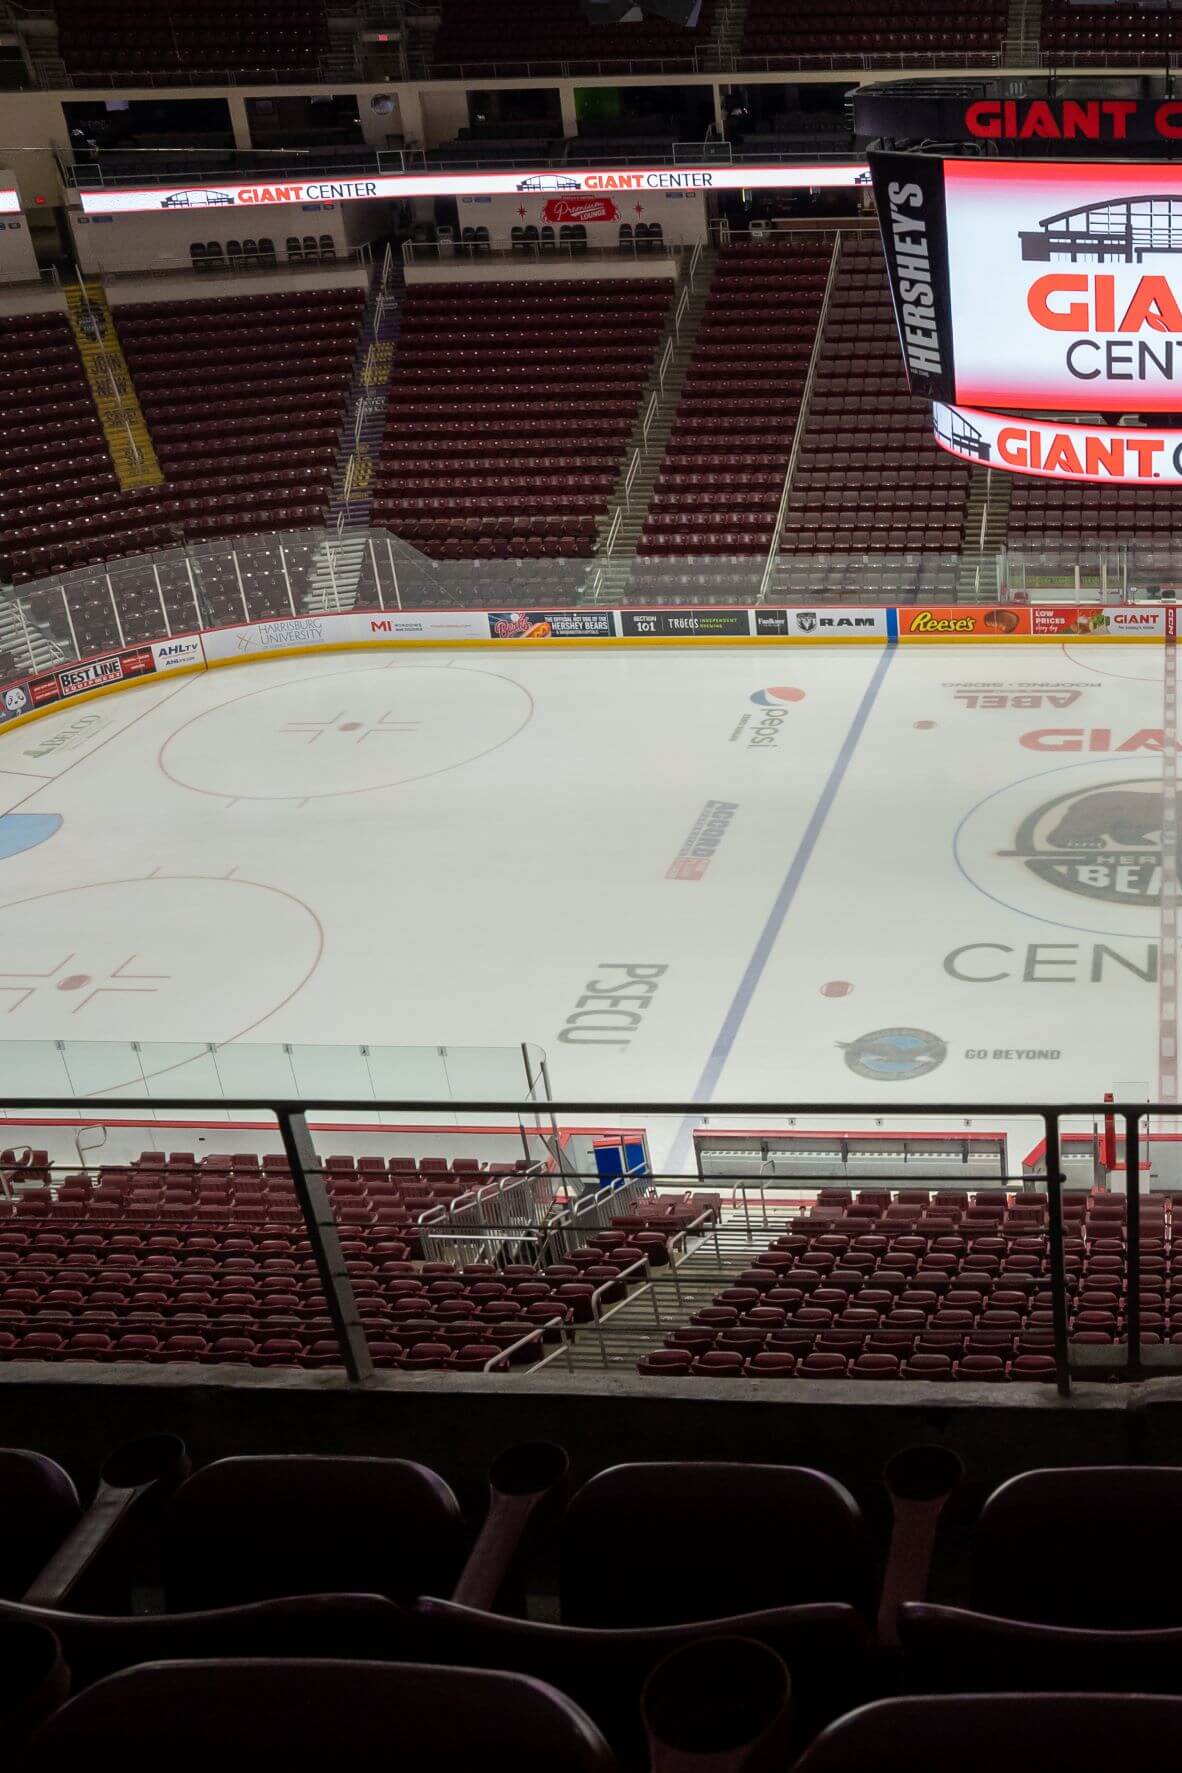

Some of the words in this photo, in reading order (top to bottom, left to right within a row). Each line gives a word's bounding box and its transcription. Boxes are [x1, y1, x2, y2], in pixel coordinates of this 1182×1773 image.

[965, 100, 1137, 139] GIANT
[584, 174, 644, 189] GIANT
[646, 173, 712, 187] CENTER
[236, 186, 303, 203] GIANT
[306, 182, 377, 199] CENTER
[888, 182, 942, 374] HERSHEY'S
[997, 428, 1164, 477] GIANT
[258, 618, 322, 638] HARRISBURG
[370, 621, 392, 632] MI
[552, 622, 583, 630] HERSHEY
[585, 622, 608, 630] BEARS
[636, 622, 655, 631] 101
[819, 618, 875, 626] RAM
[910, 611, 975, 633] Reese's
[1114, 615, 1159, 624] GIANT
[260, 628, 323, 645] UNIVERSITY
[61, 668, 93, 688] BEST
[93, 659, 120, 678] LINE
[954, 691, 1083, 709] ABEL
[748, 708, 790, 747] pepsi
[557, 963, 669, 1045] PSECU
[964, 1049, 988, 1060] GO
[992, 1049, 1061, 1060] BEYOND
